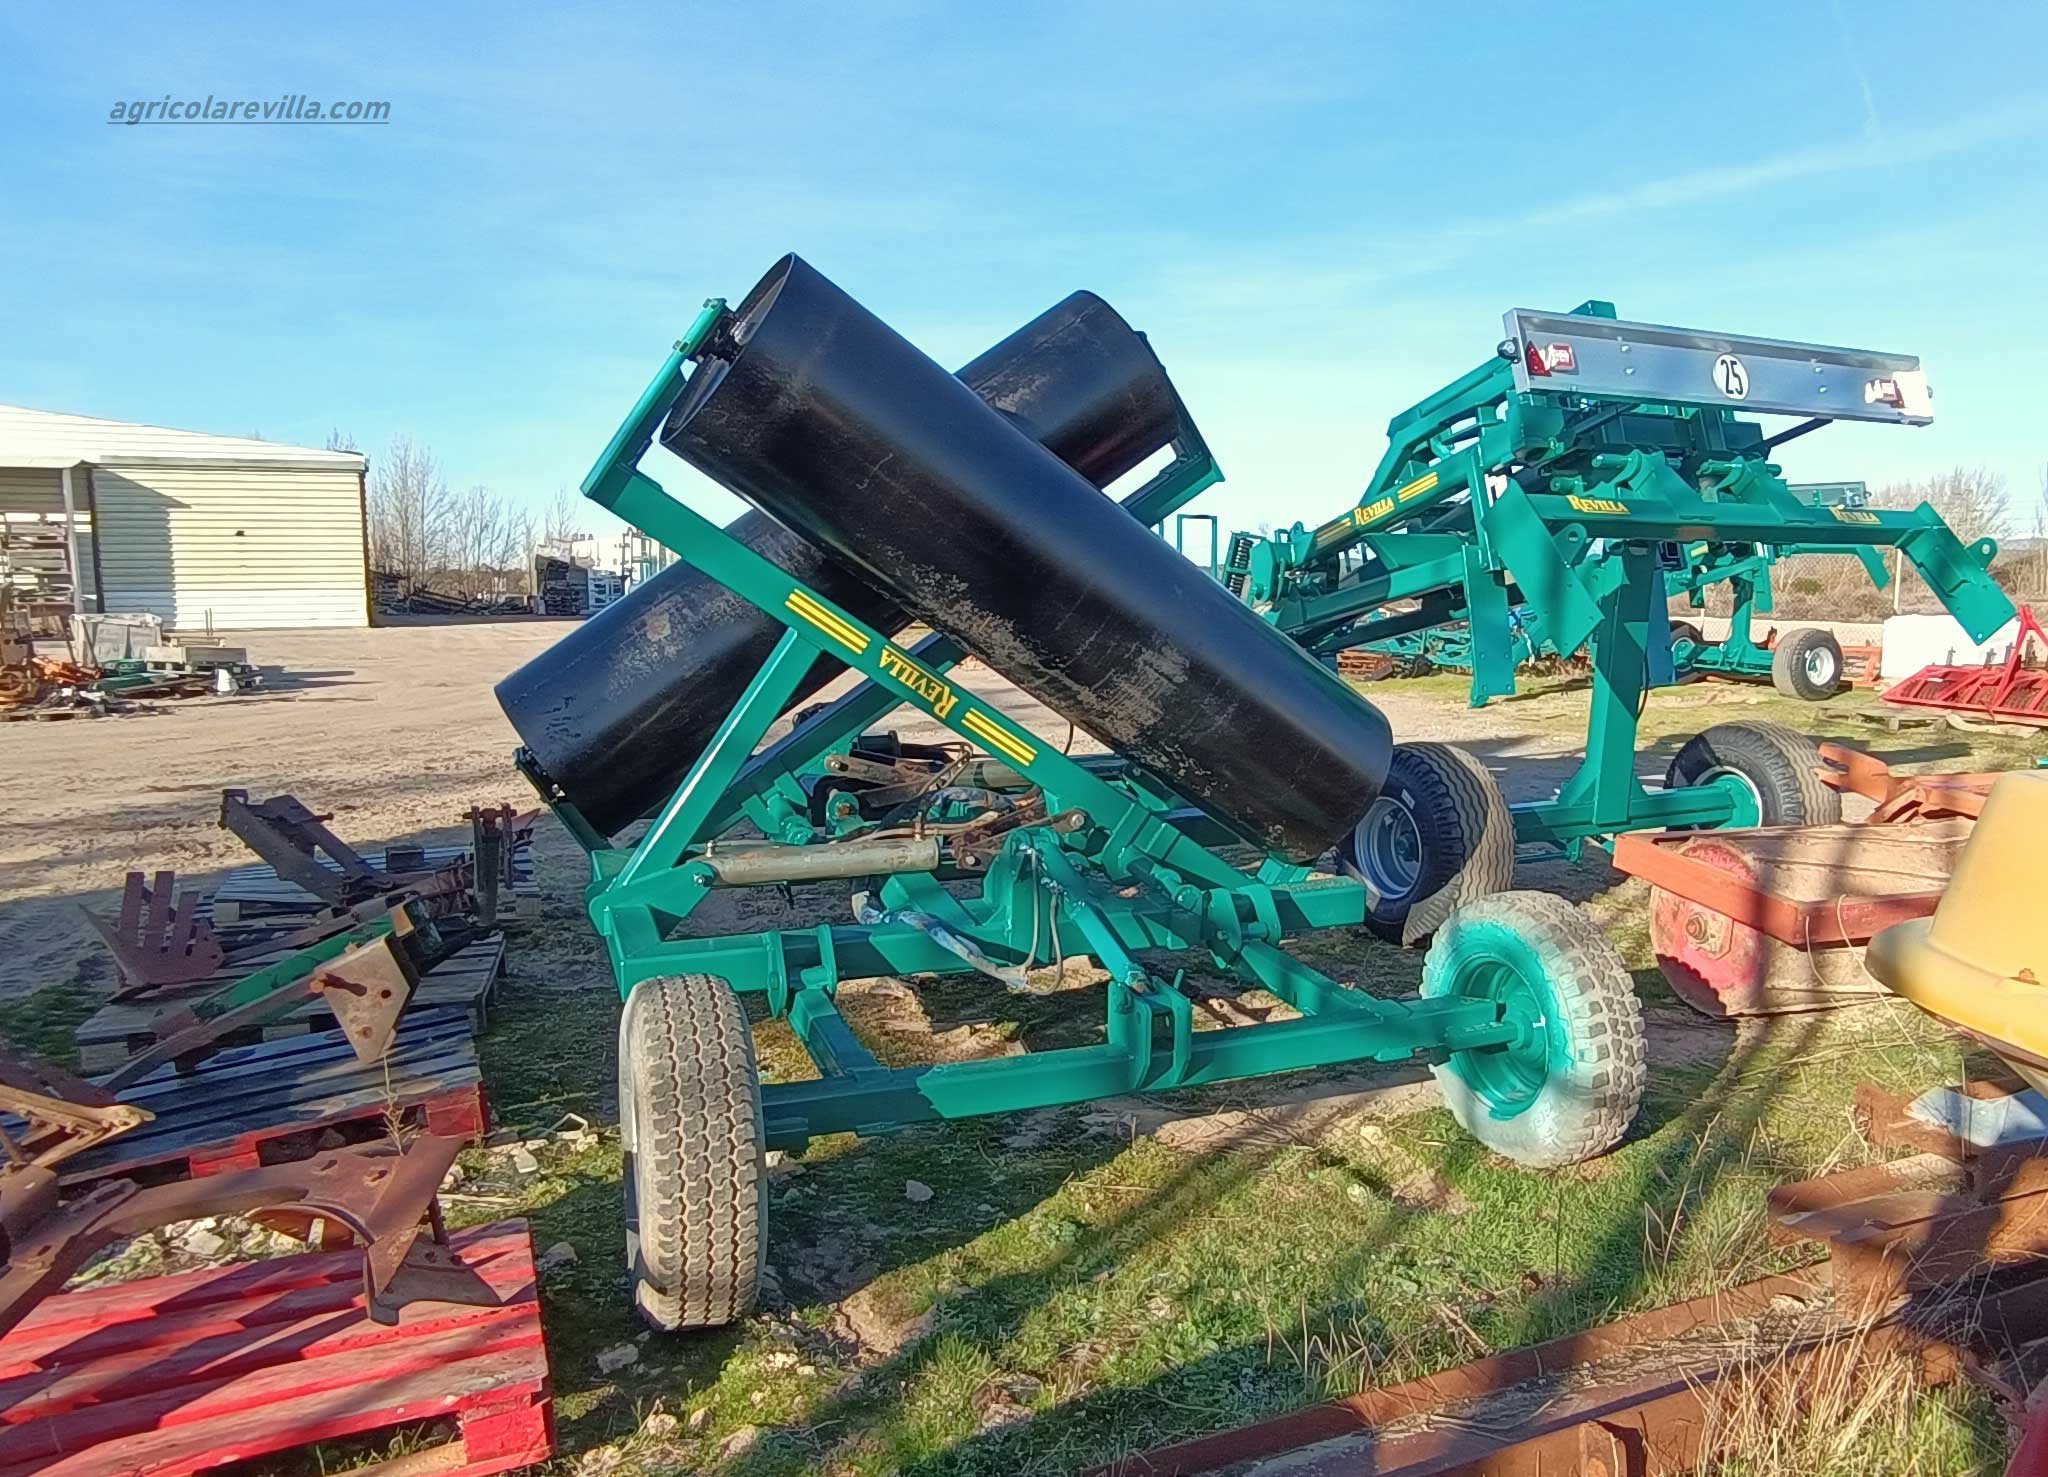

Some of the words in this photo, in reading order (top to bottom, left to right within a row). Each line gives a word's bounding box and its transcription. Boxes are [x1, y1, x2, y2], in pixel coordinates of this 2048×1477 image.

[1720, 359, 1744, 395] 25
[1353, 496, 1395, 525] REVILLA
[1566, 494, 1632, 514] REVILLA
[879, 644, 959, 719] REVILLA
